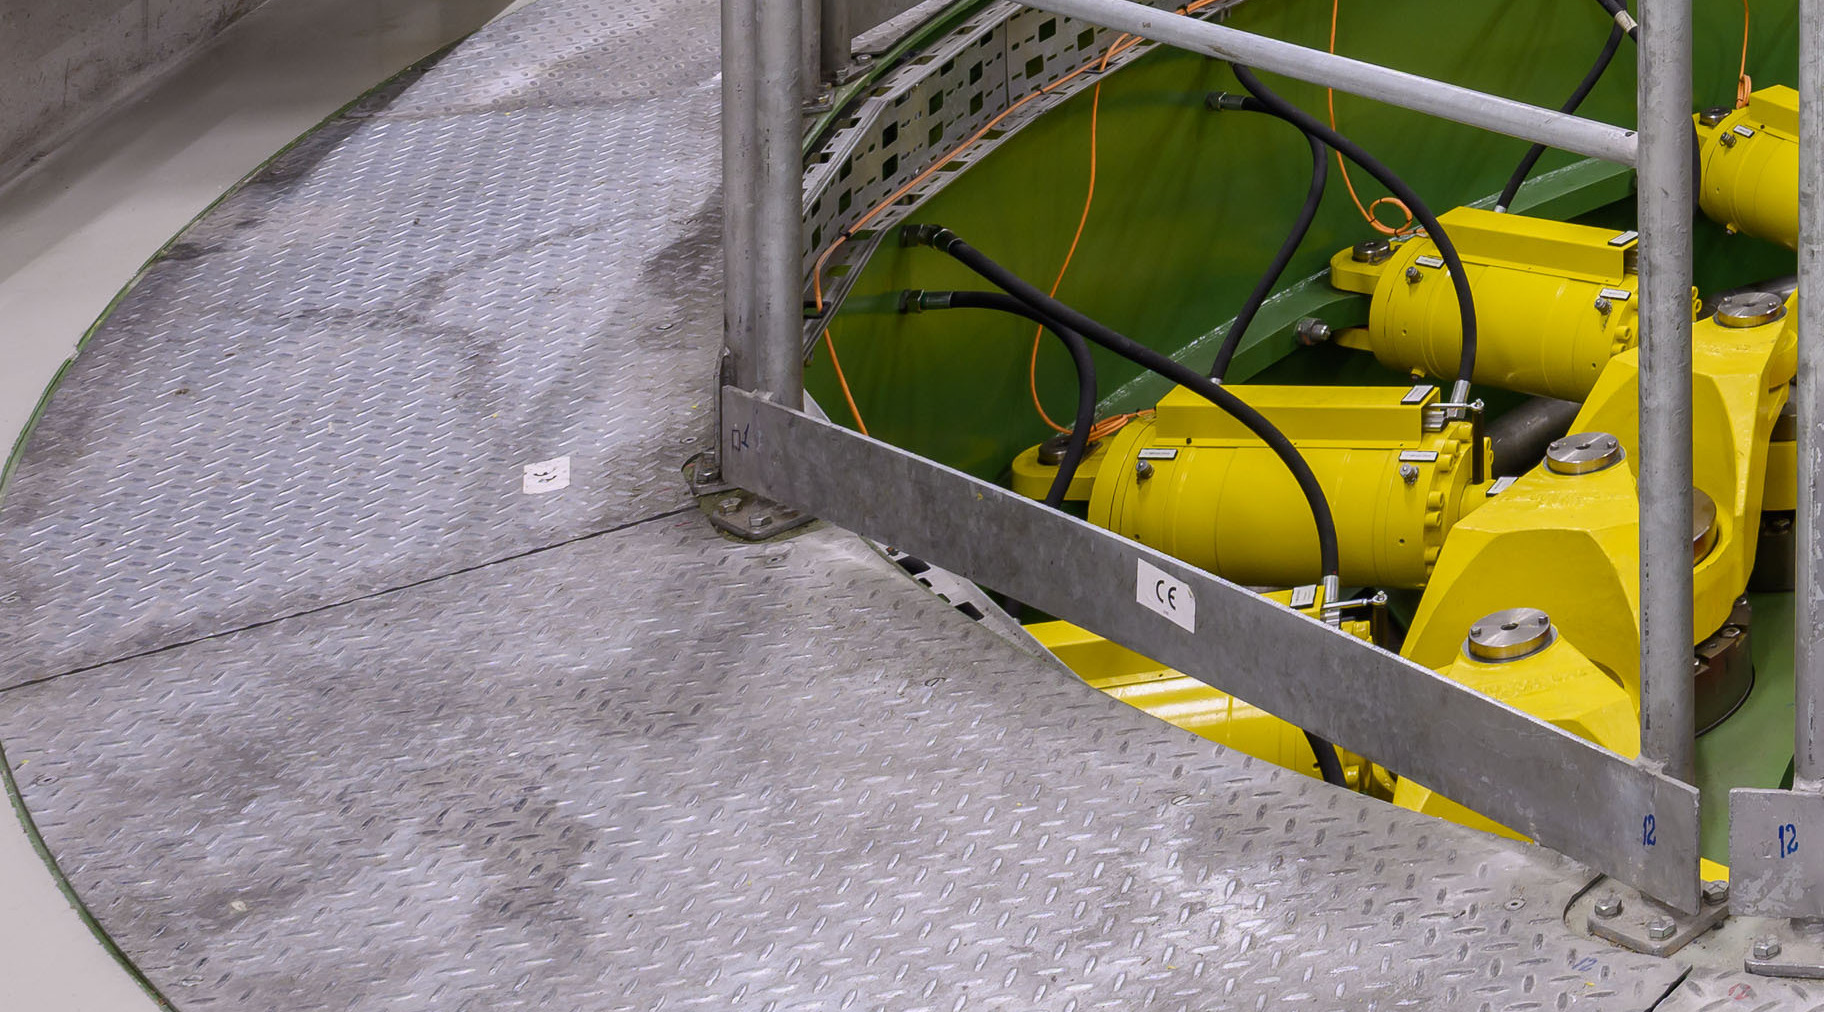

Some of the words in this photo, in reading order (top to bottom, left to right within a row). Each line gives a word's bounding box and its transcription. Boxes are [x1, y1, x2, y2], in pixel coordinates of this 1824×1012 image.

[1155, 579, 1177, 610] CE
[1642, 813, 1656, 846] 12
[1778, 823, 1798, 858] 12
